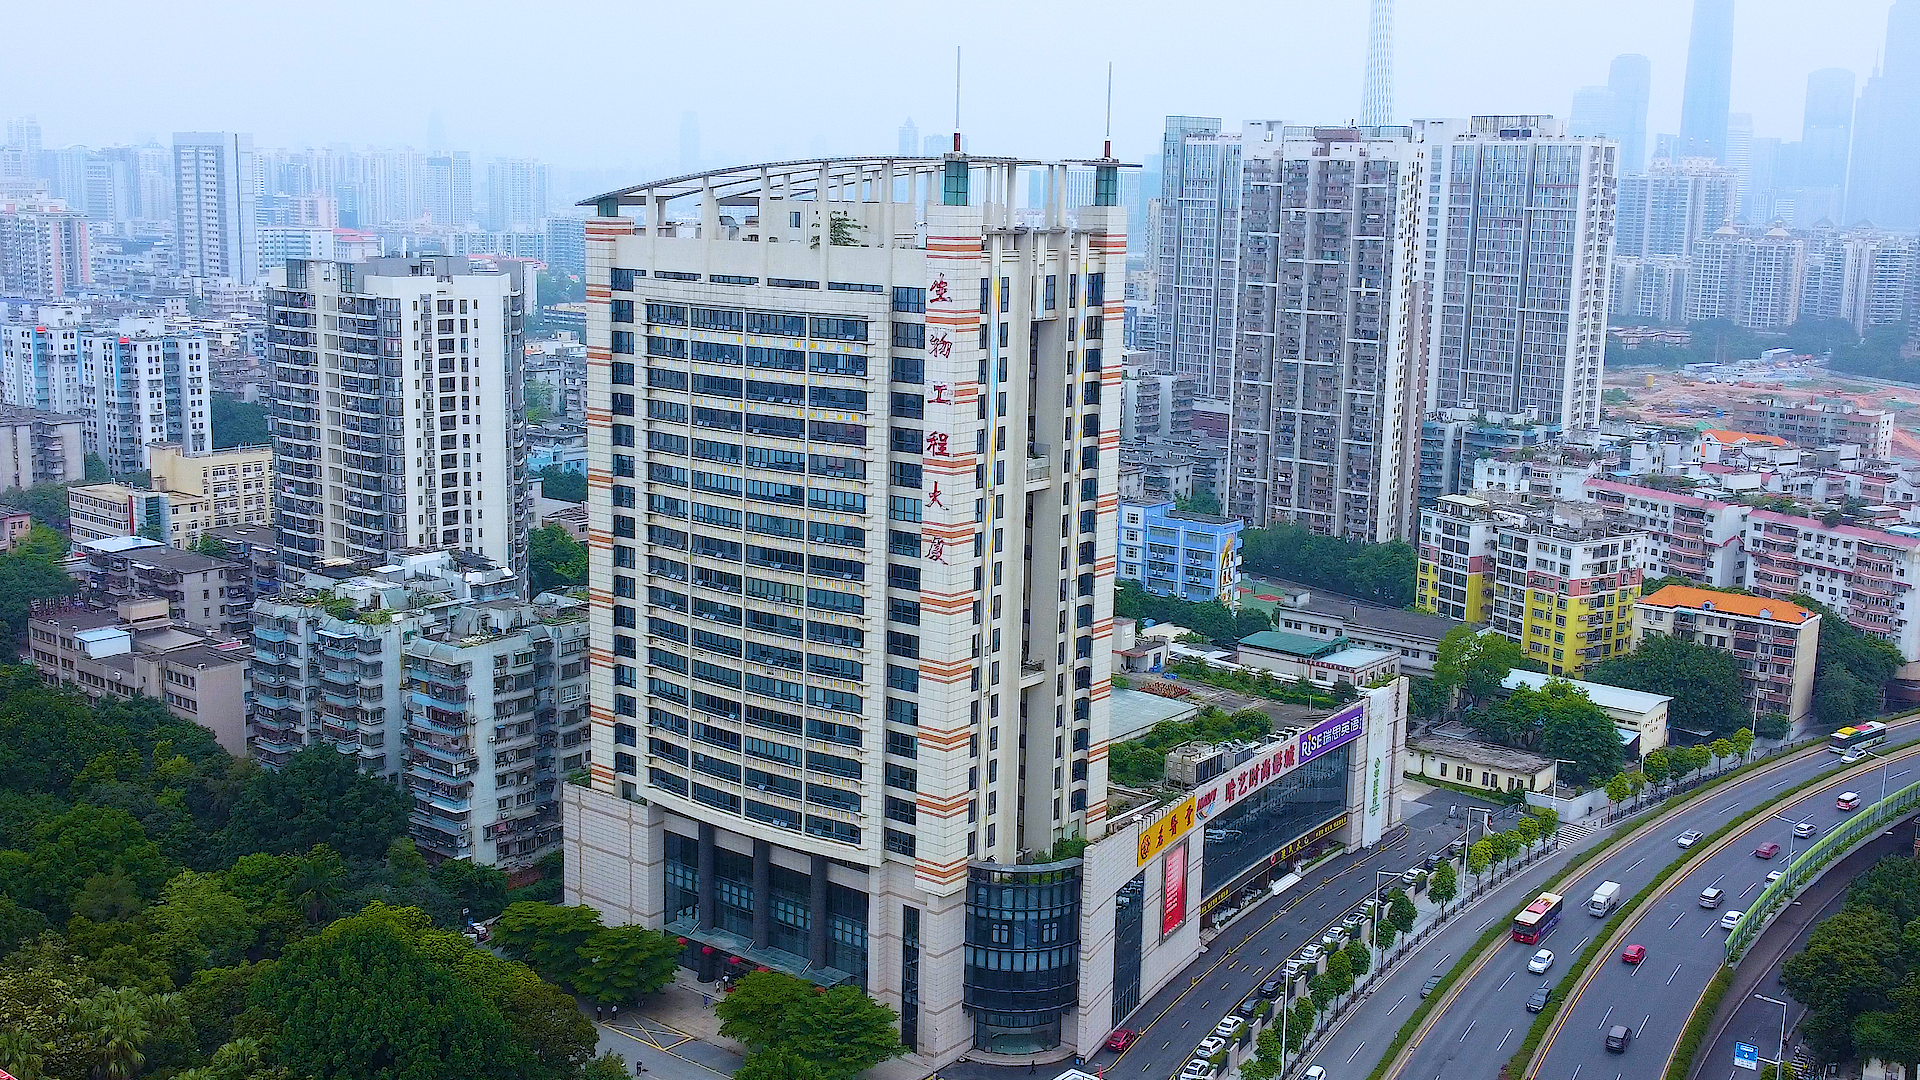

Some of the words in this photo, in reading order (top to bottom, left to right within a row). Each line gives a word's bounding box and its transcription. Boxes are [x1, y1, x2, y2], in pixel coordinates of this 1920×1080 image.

[925, 272, 953, 566] 生物工程大厦
